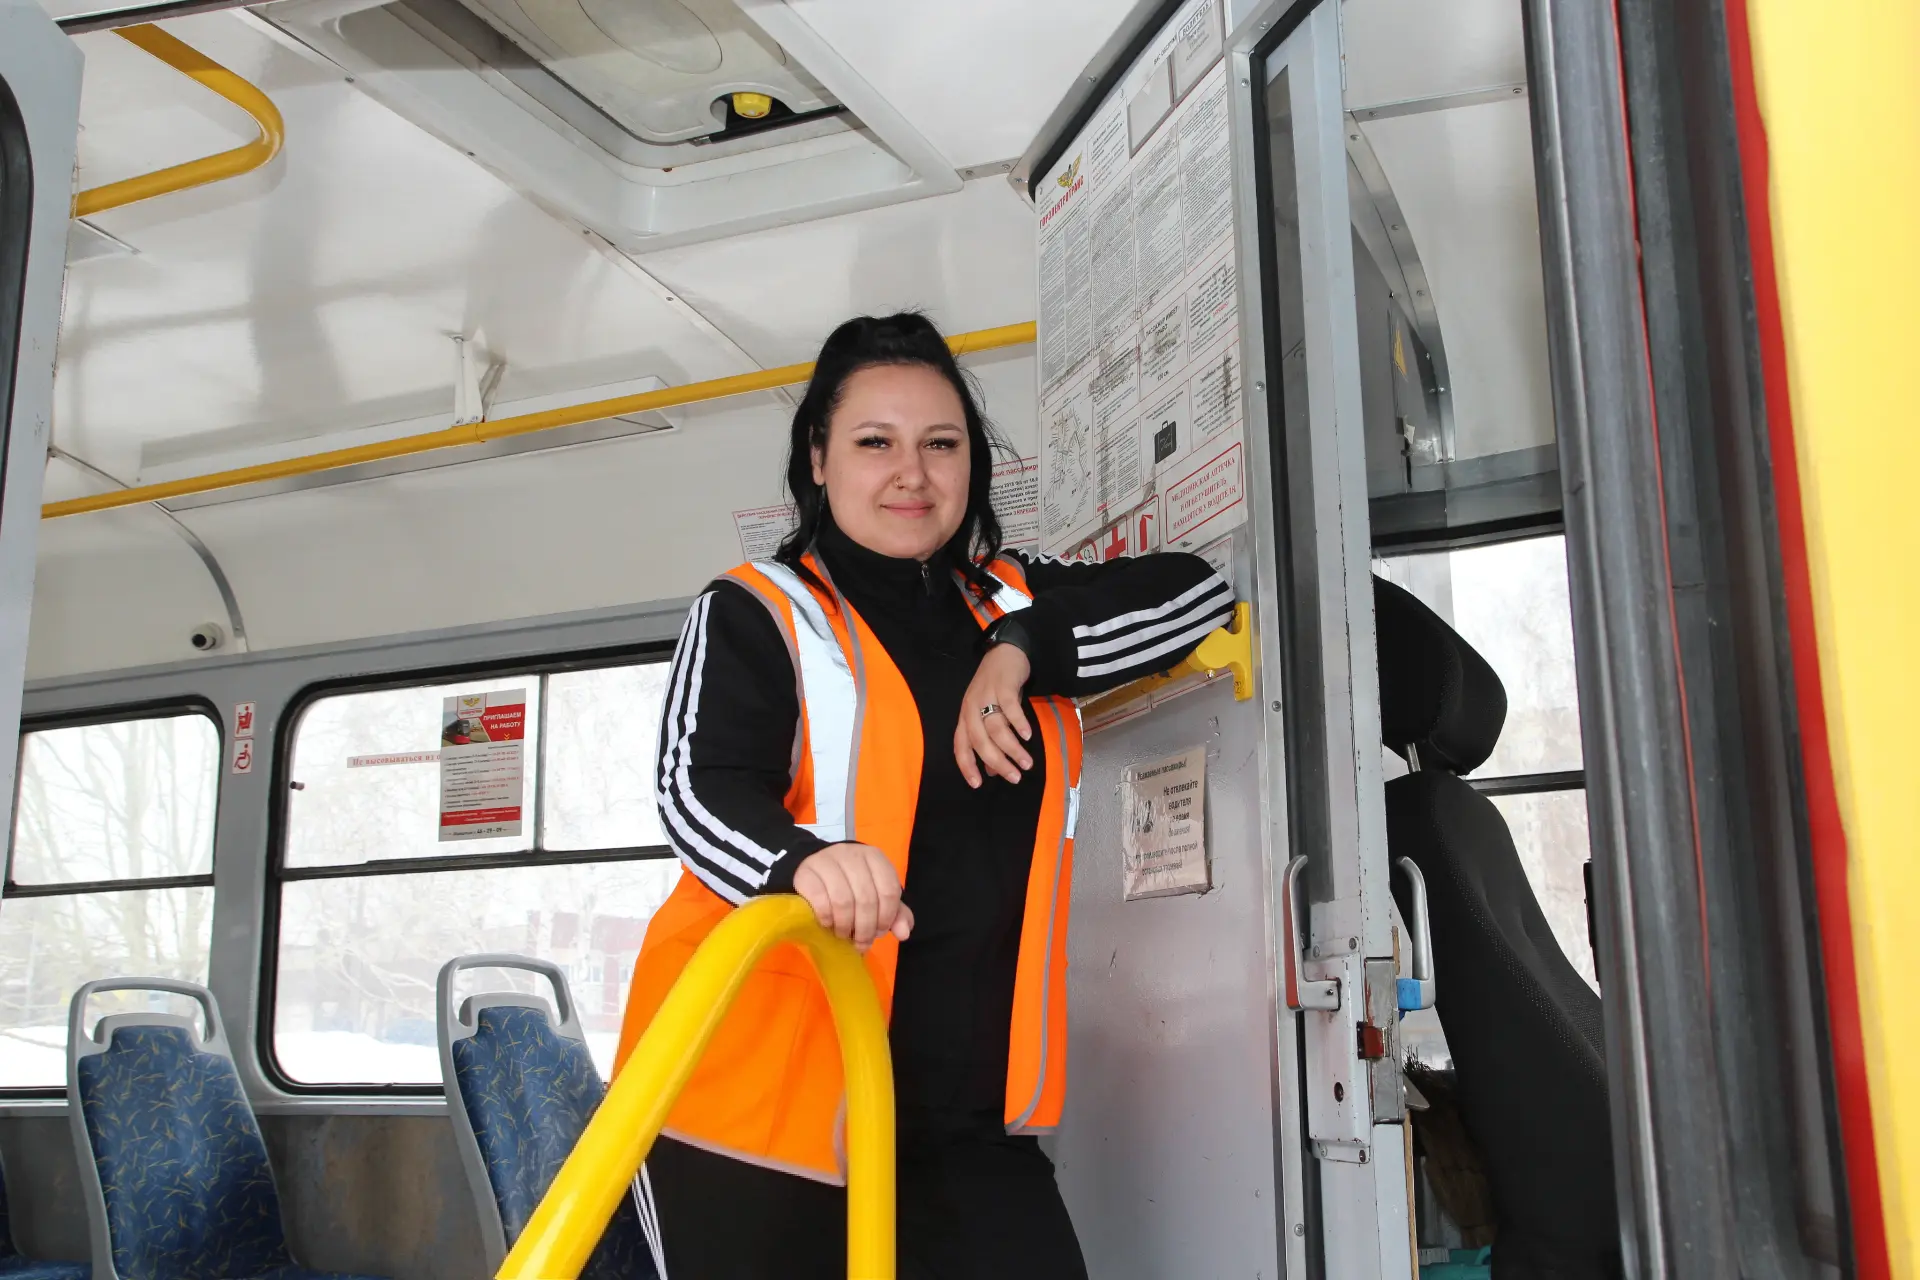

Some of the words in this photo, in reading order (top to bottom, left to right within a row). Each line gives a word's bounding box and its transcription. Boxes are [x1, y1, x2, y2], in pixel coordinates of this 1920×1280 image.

[1182, 3, 1208, 36] ВОДИТЕЛЬ
[1040, 174, 1084, 230] ГОРЭЛЕКТРОТРАНС
[1172, 472, 1210, 503] МЕДИЦИНСКАЯ
[1210, 457, 1235, 478] АПТЕЧКА
[1173, 508, 1203, 530] НАХОДИТСЯ
[483, 712, 522, 720] ПРИГЛАШАЕМ
[366, 756, 422, 764] высовываться
[1164, 786, 1169, 796] Не
[1170, 780, 1198, 794] отвлекайте
[1169, 797, 1191, 810] водителя
